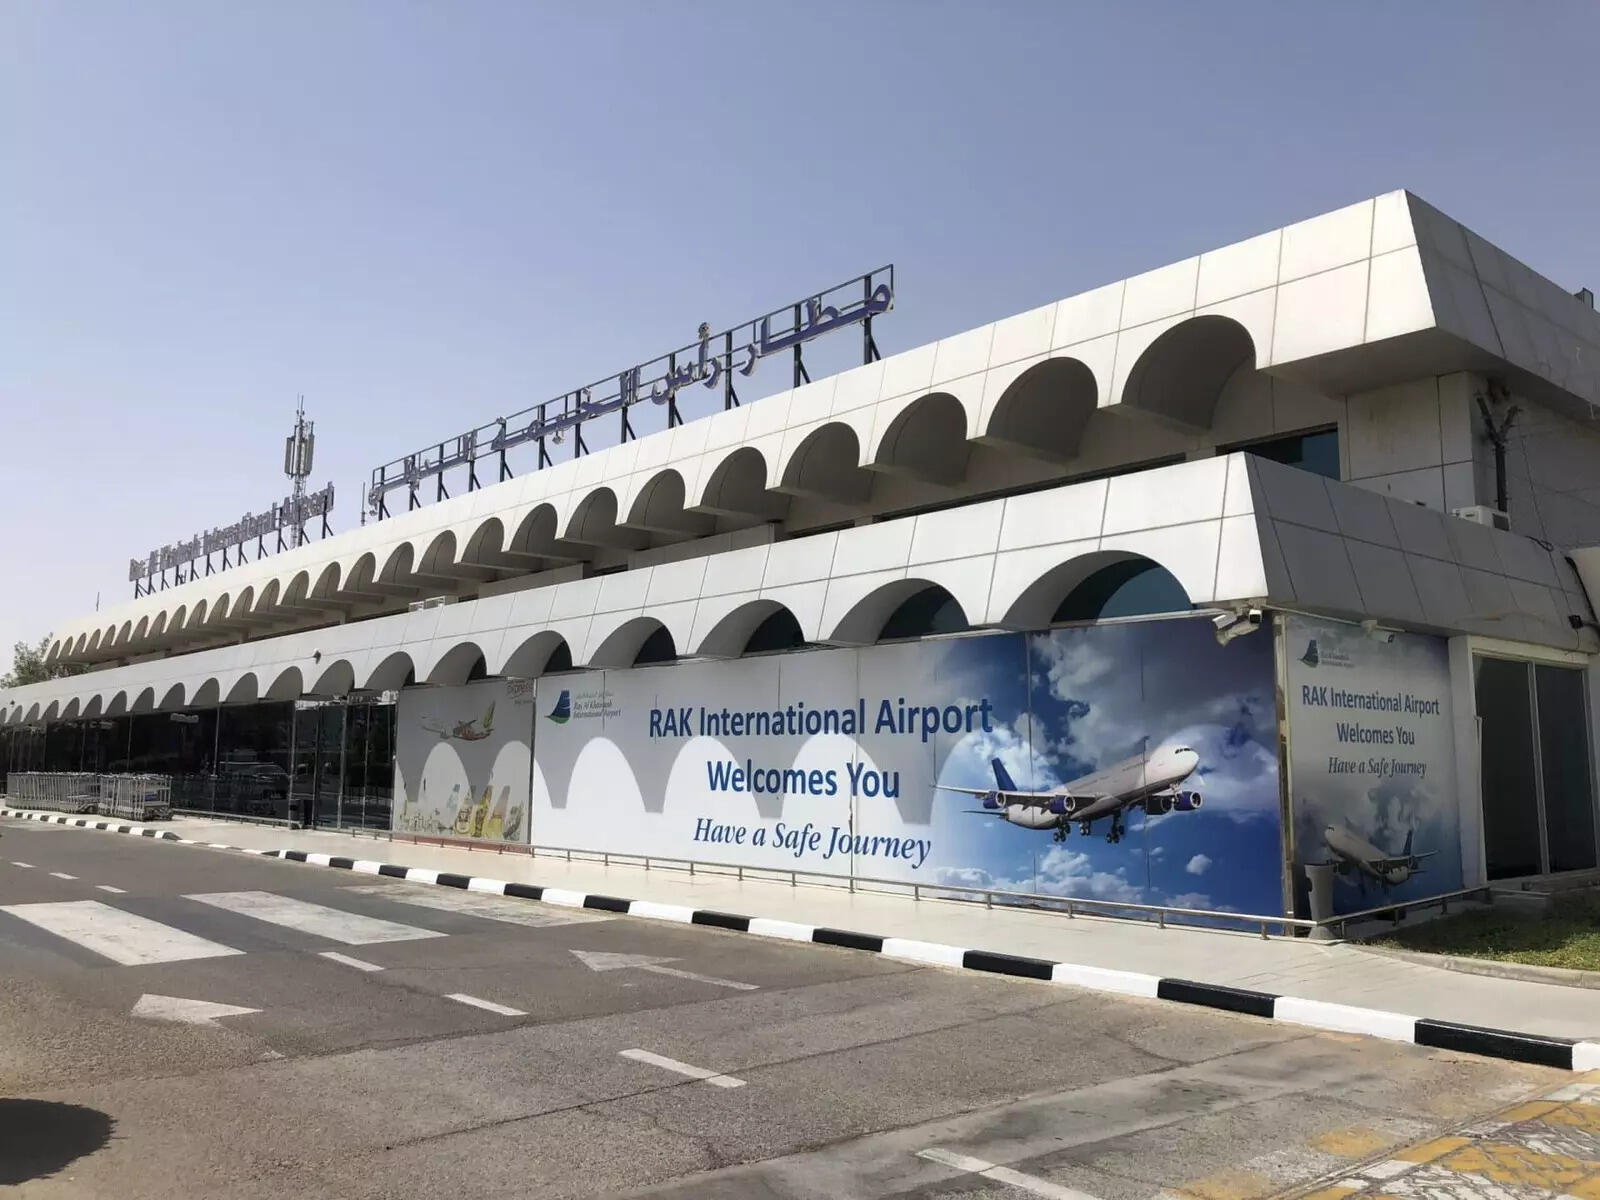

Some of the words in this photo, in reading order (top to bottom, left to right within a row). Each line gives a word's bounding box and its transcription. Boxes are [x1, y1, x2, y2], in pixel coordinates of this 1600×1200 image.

[739, 284, 894, 376] مطار
[651, 322, 722, 405] رأس
[650, 707, 693, 737] RAK
[700, 698, 865, 736] International
[875, 697, 993, 743] Airport
[1302, 685, 1327, 706] RAK
[1331, 687, 1401, 711] International
[1404, 694, 1440, 718] Airport
[1336, 722, 1393, 744] Welcomes
[1396, 726, 1415, 745] You
[707, 759, 837, 797] Welcomes
[846, 762, 899, 798] You
[1328, 757, 1356, 774] Have
[1359, 763, 1365, 774] a
[1368, 758, 1387, 777] Safe
[1390, 758, 1427, 778] Journey
[693, 817, 746, 845] Have
[752, 829, 766, 847] a
[772, 822, 821, 858] Safe
[823, 826, 931, 869] Journey
